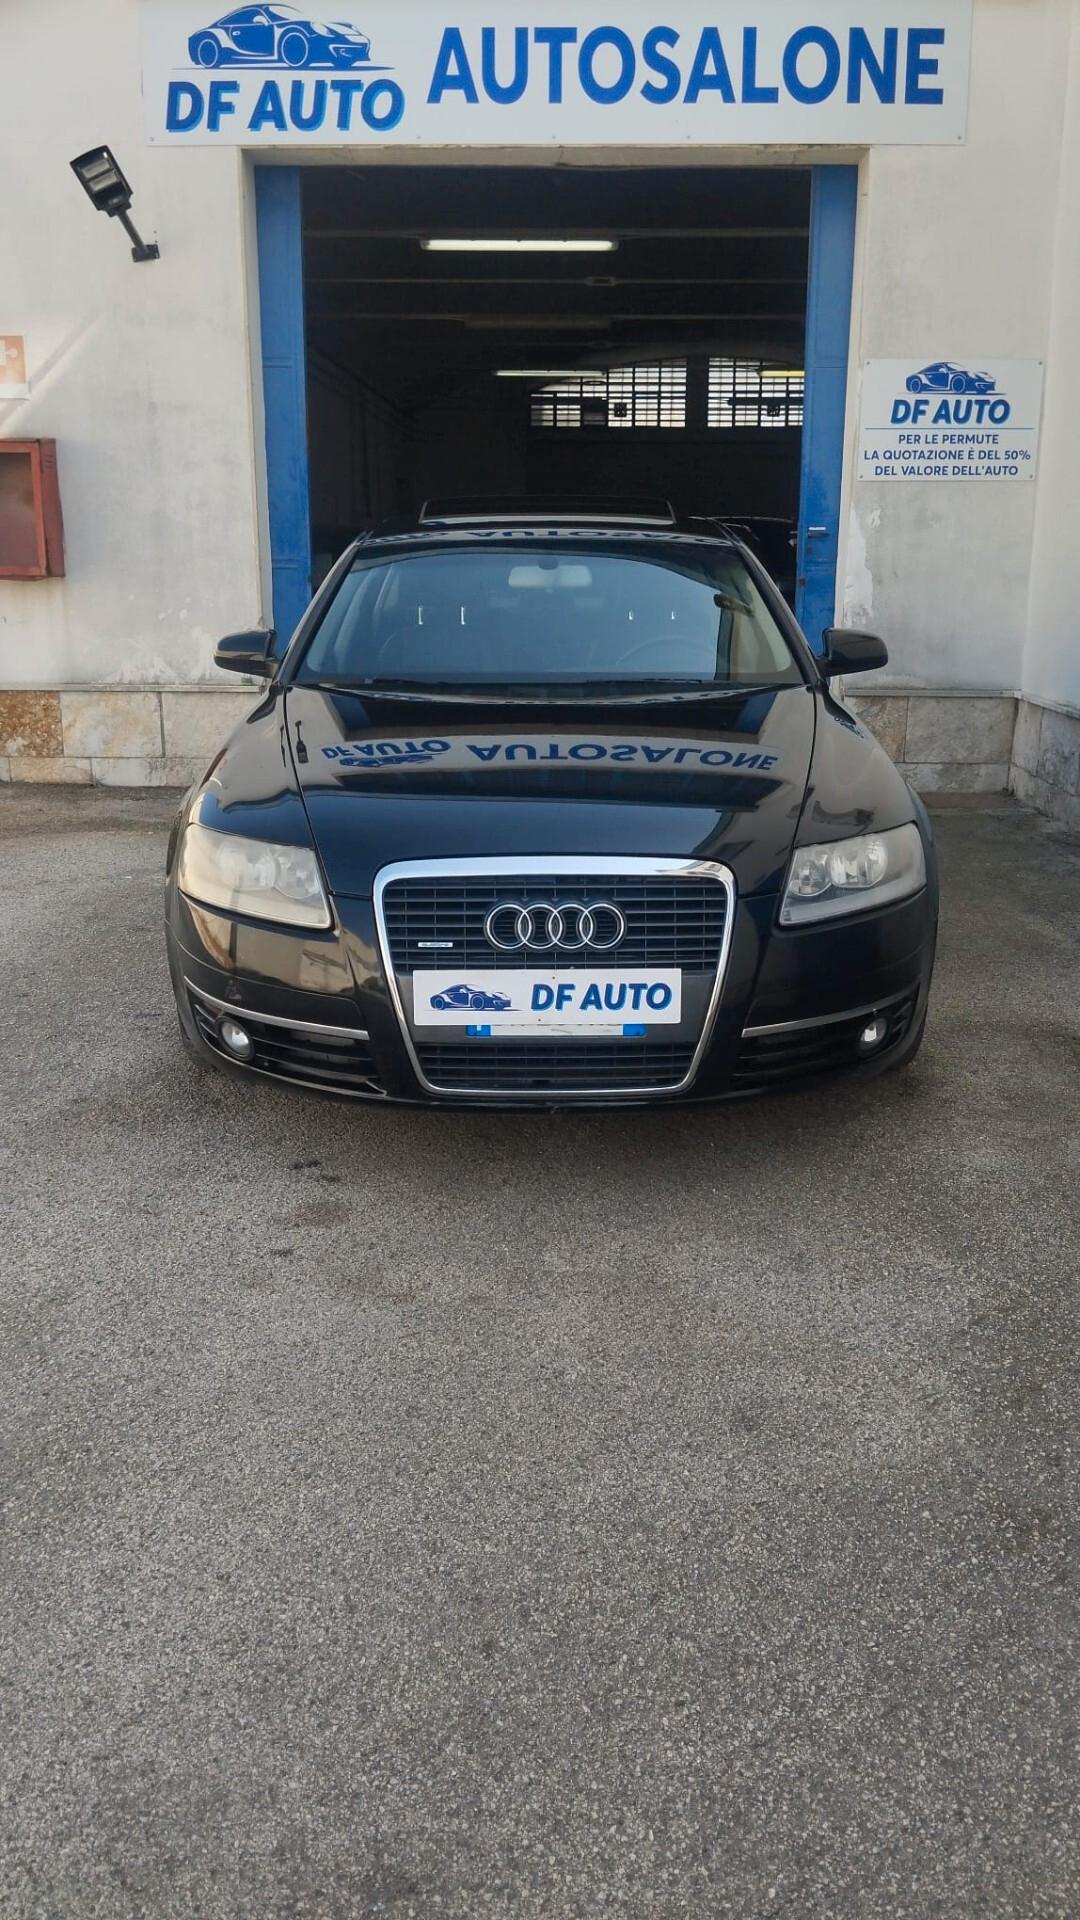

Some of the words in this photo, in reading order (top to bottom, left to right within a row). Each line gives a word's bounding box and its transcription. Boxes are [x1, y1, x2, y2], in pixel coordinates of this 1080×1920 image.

[426, 27, 945, 105] AUTOSALONE
[166, 81, 240, 132] DF
[247, 79, 405, 132] AUTO
[890, 399, 929, 424] DF
[931, 399, 1010, 424] AUTO
[898, 434, 921, 444] PER
[925, 434, 938, 444] LE
[942, 434, 999, 444] PERMUTE
[864, 450, 879, 460] LA
[883, 450, 964, 460] QUOTAZIONE
[978, 450, 1000, 460] DEL
[1004, 450, 1031, 460] 50%
[875, 466, 897, 475] DEL
[901, 466, 948, 475] VALORE
[952, 466, 1018, 475] DELL'AUTO
[530, 983, 575, 1011] DF
[580, 983, 673, 1011] AUTO
